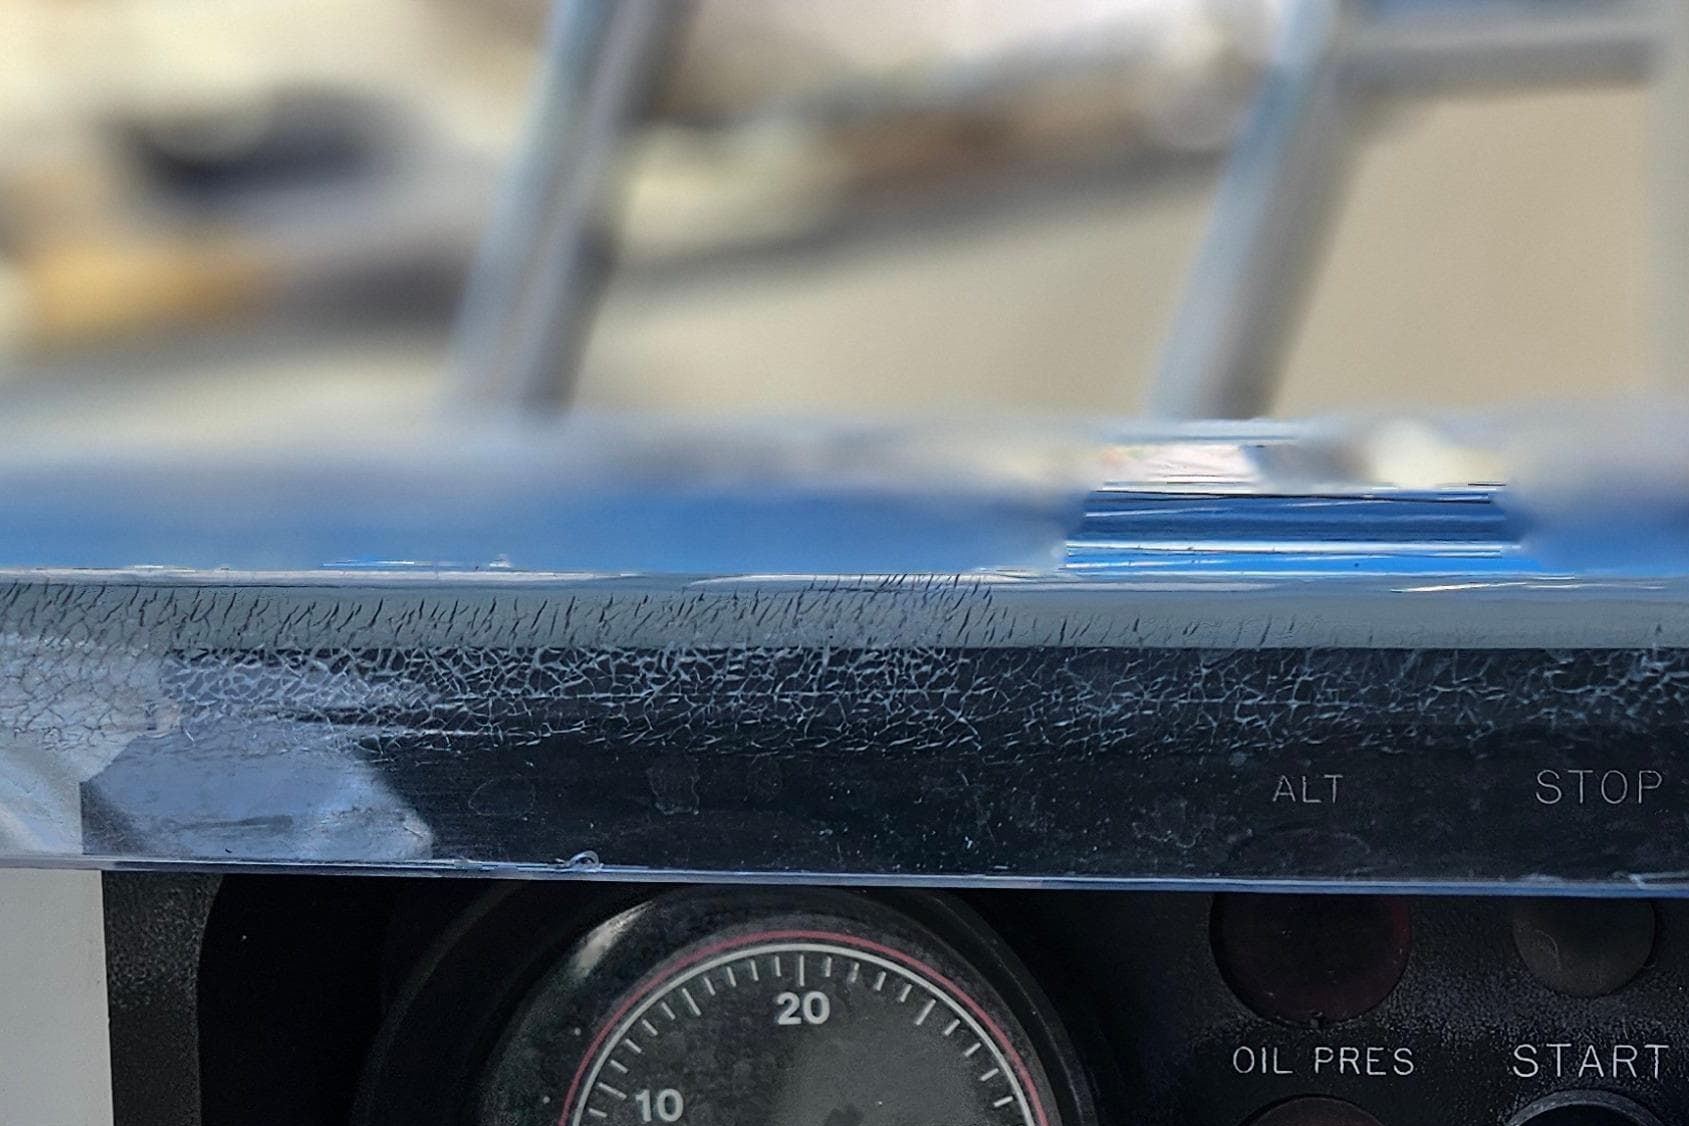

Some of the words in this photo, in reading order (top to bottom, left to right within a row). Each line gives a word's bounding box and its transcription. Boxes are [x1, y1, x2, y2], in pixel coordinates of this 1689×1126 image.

[1272, 774, 1344, 804] ALT
[1534, 768, 1664, 805] STOP
[776, 990, 831, 1026] 20
[1232, 1046, 1294, 1075] OIL
[1313, 1046, 1416, 1076] PRES
[1511, 1043, 1671, 1079] START
[635, 1088, 684, 1122] 10
